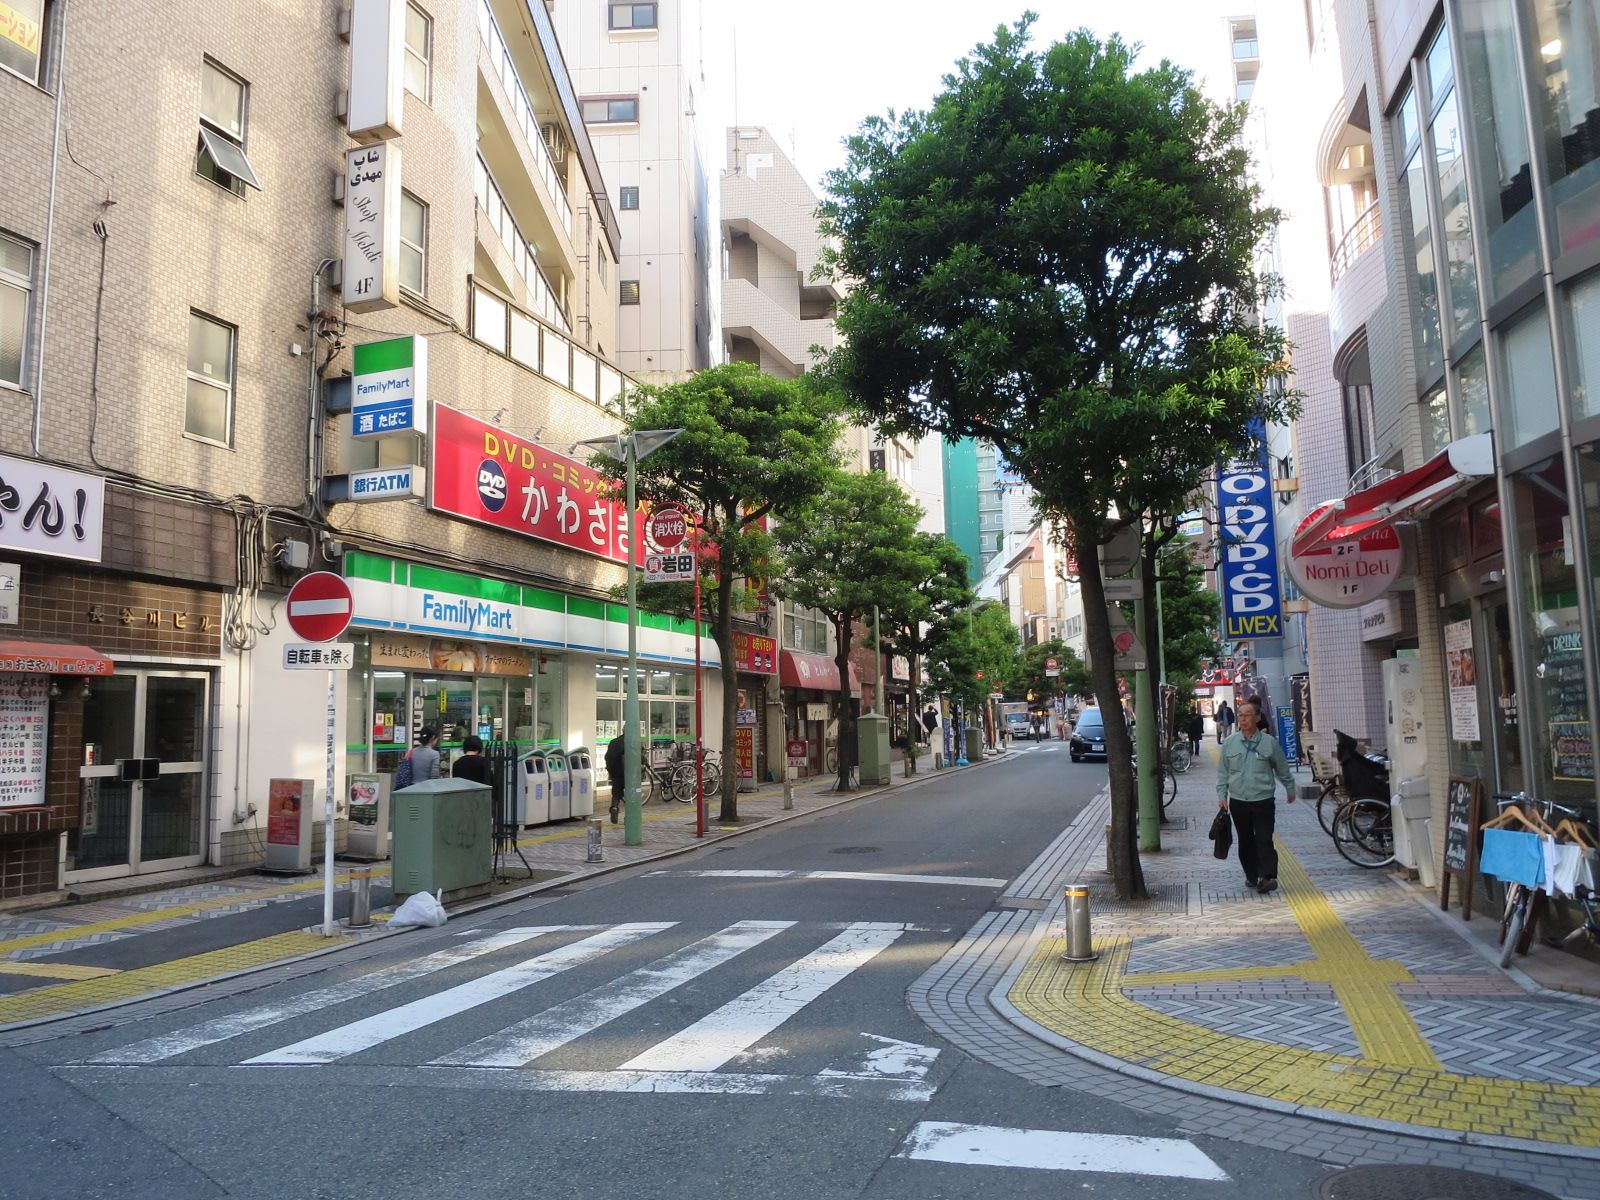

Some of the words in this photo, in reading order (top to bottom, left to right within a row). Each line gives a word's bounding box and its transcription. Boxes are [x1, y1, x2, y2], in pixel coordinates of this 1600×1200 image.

[353, 196, 379, 223] Shop
[354, 277, 374, 294] 4F
[357, 378, 410, 395] FamilyMart
[359, 414, 375, 433] 酒
[378, 411, 408, 428] たばこ
[353, 473, 410, 494] 銀行ATM
[479, 469, 506, 489] DVD
[654, 519, 684, 538] 消火栓
[662, 555, 693, 574] 岩田
[1305, 562, 1350, 581] Nomi
[1355, 559, 1390, 577] Deli
[89, 604, 212, 632] 長谷川ビル
[423, 593, 512, 631] FamilyMart
[1228, 614, 1280, 635] LIVEX
[287, 648, 350, 664] 自転車を除く
